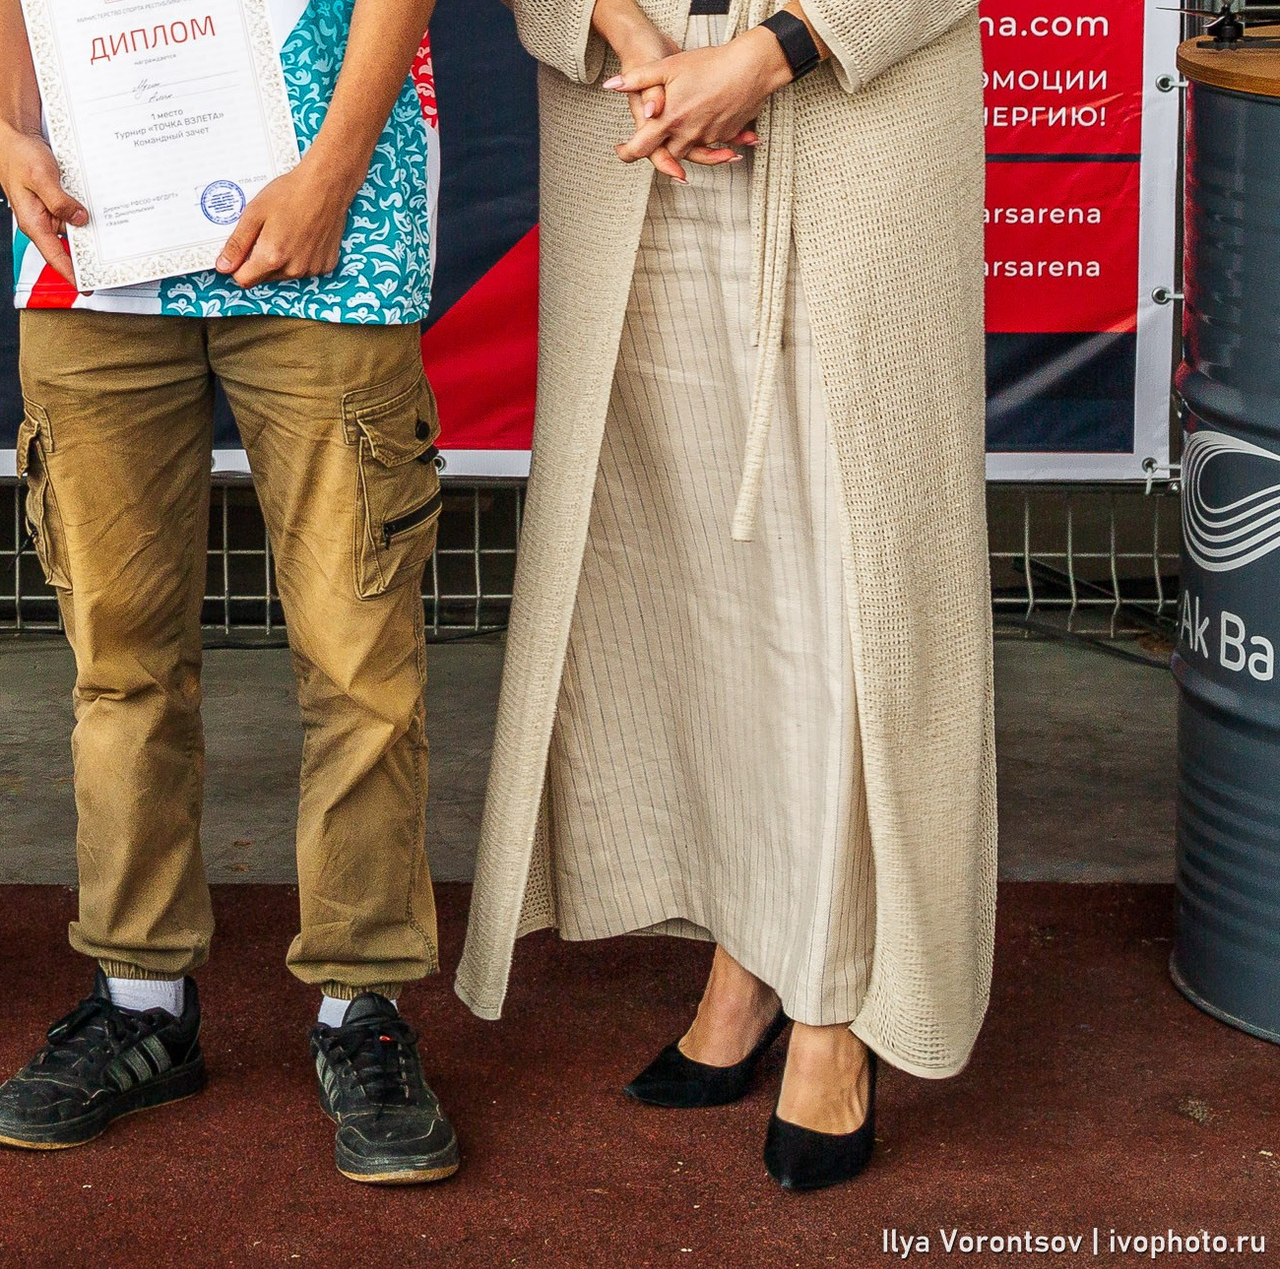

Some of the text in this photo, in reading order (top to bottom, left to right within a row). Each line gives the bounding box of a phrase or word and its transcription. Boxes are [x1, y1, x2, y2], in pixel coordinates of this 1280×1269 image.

[978, 16, 1109, 37] na.com
[90, 15, 216, 65] ДИПЛОМ
[114, 112, 225, 140] Турнир «ТОЧКА ВЗЛЕТА»
[157, 109, 184, 120] место
[133, 126, 210, 147] Командный зачет
[1181, 589, 1275, 681] Ak Ba
